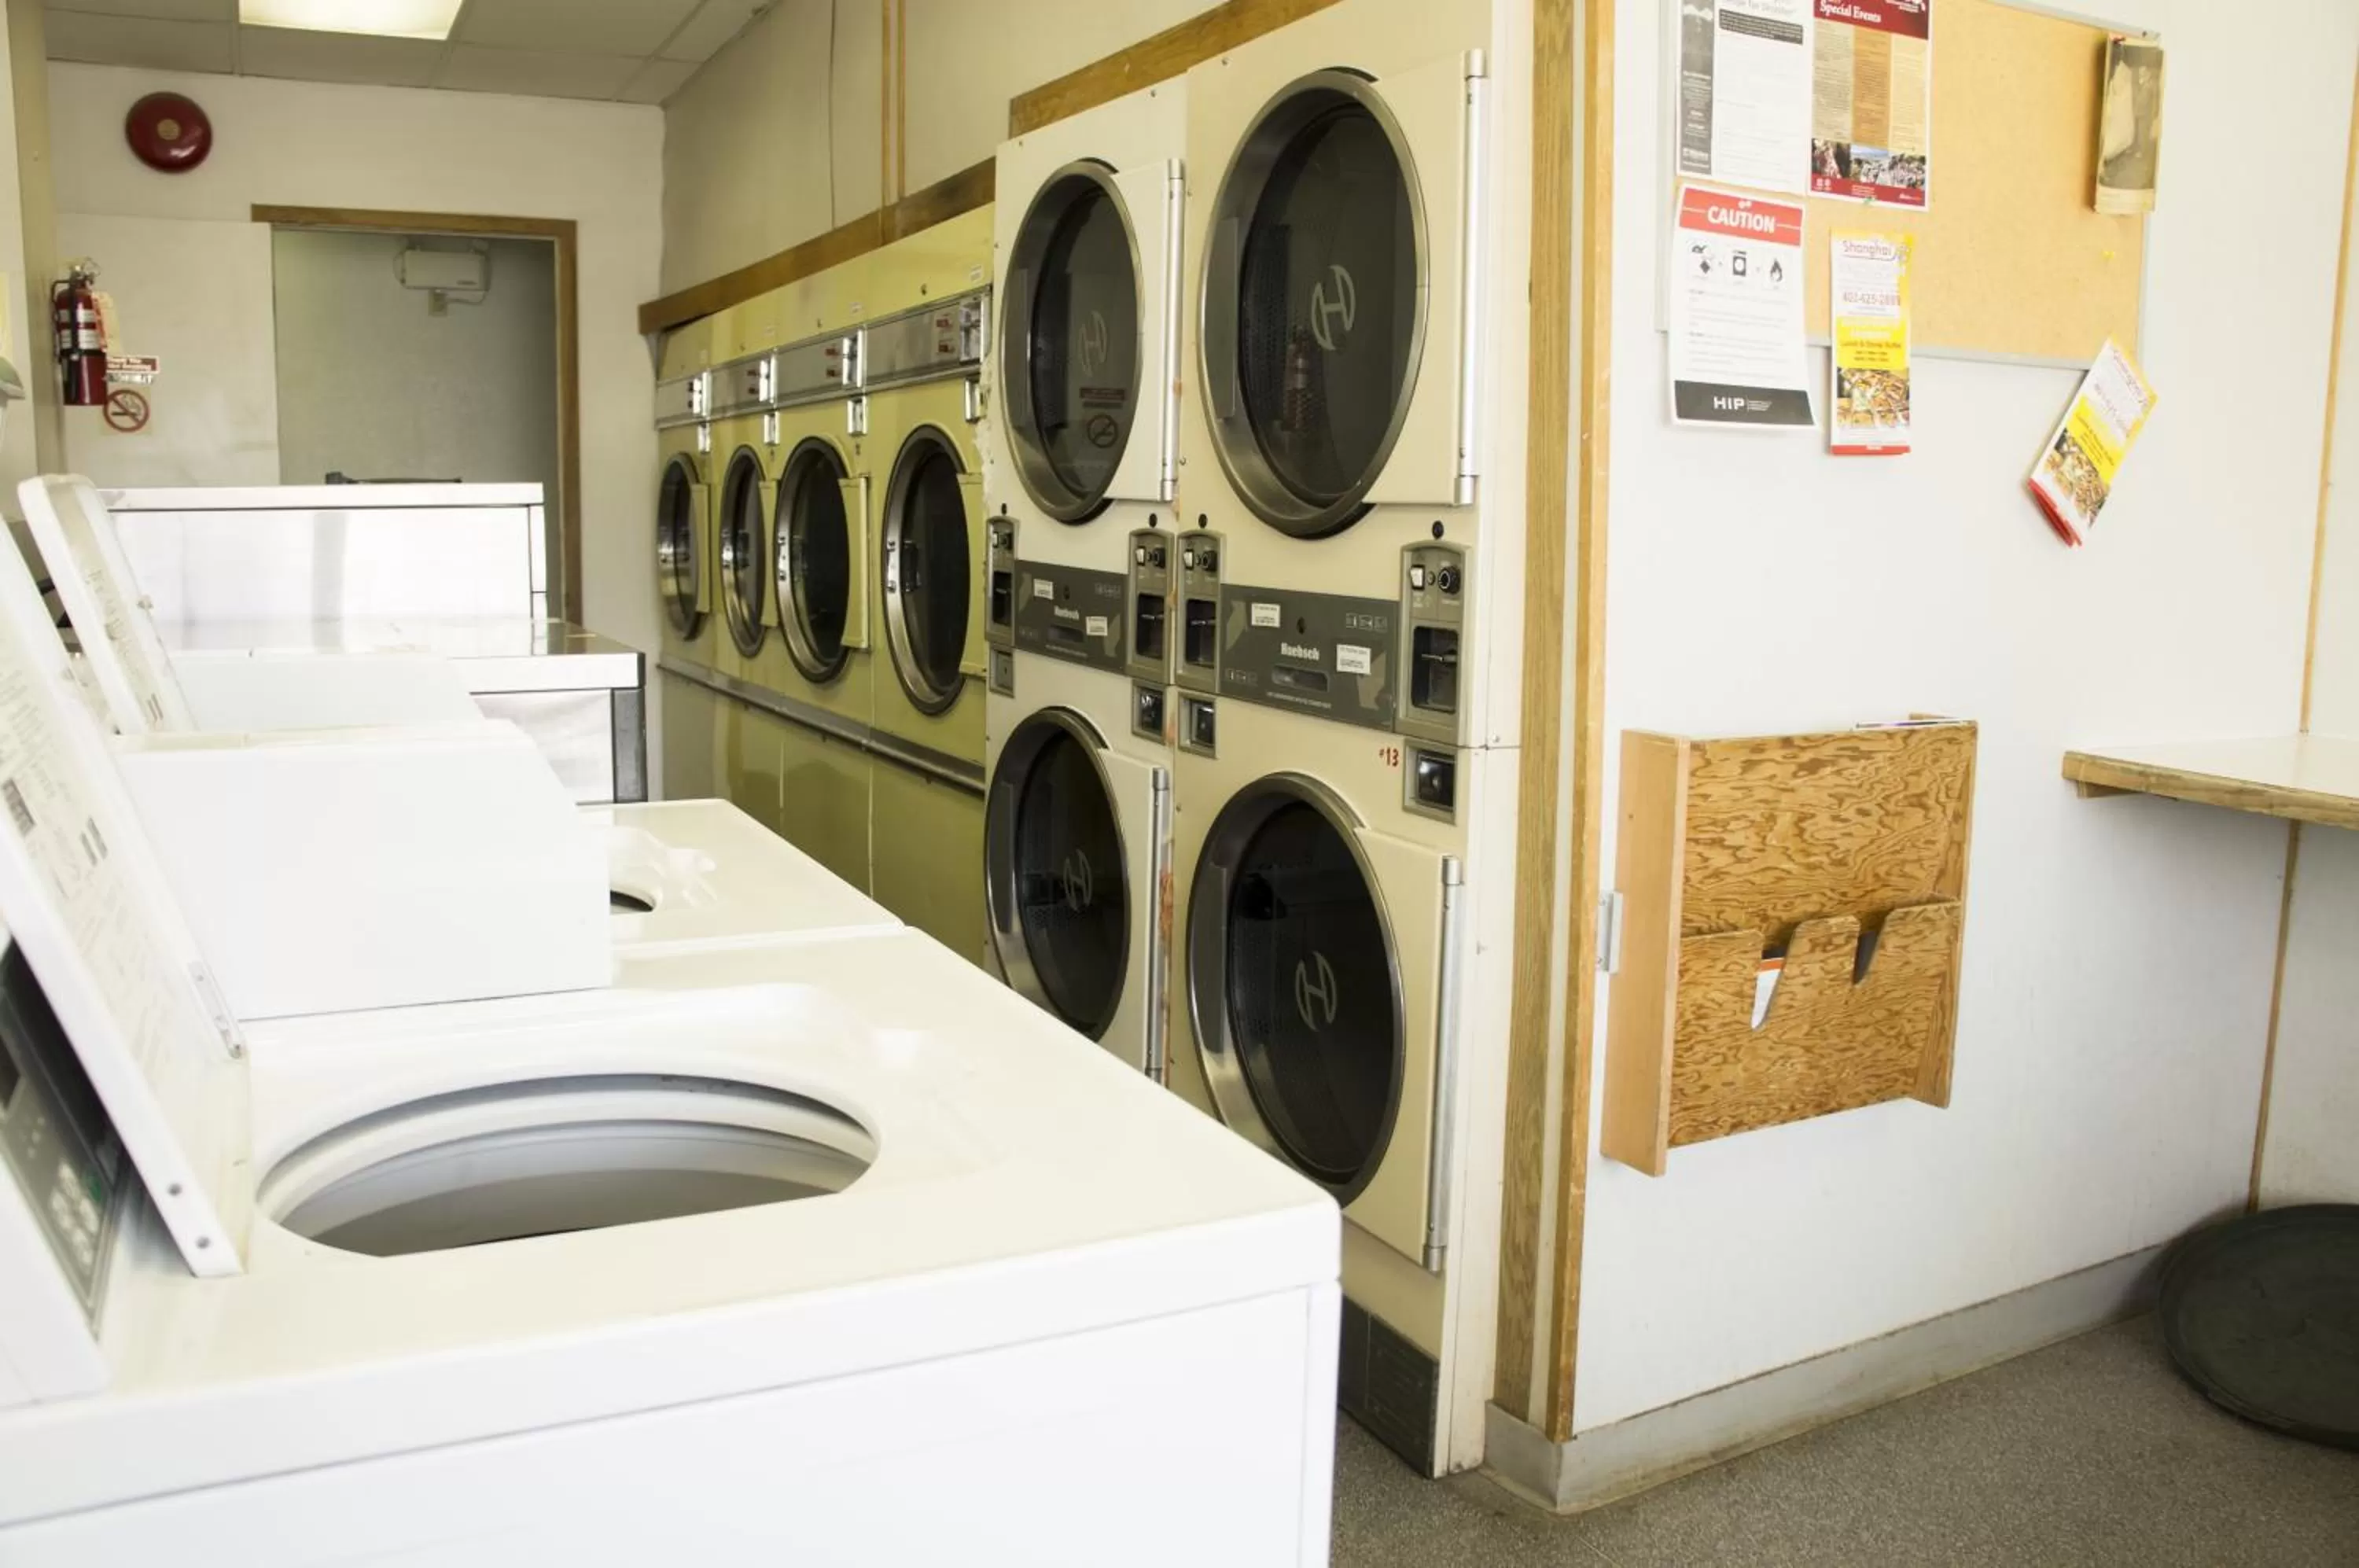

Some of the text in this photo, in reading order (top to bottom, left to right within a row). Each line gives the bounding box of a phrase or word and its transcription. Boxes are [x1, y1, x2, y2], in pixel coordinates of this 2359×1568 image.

[1820, 0, 1852, 17] Special
[1853, 6, 1882, 23] Events
[1707, 205, 1776, 234] CAUTION
[1713, 396, 1745, 410] HIP
[1379, 746, 1400, 768] #13
